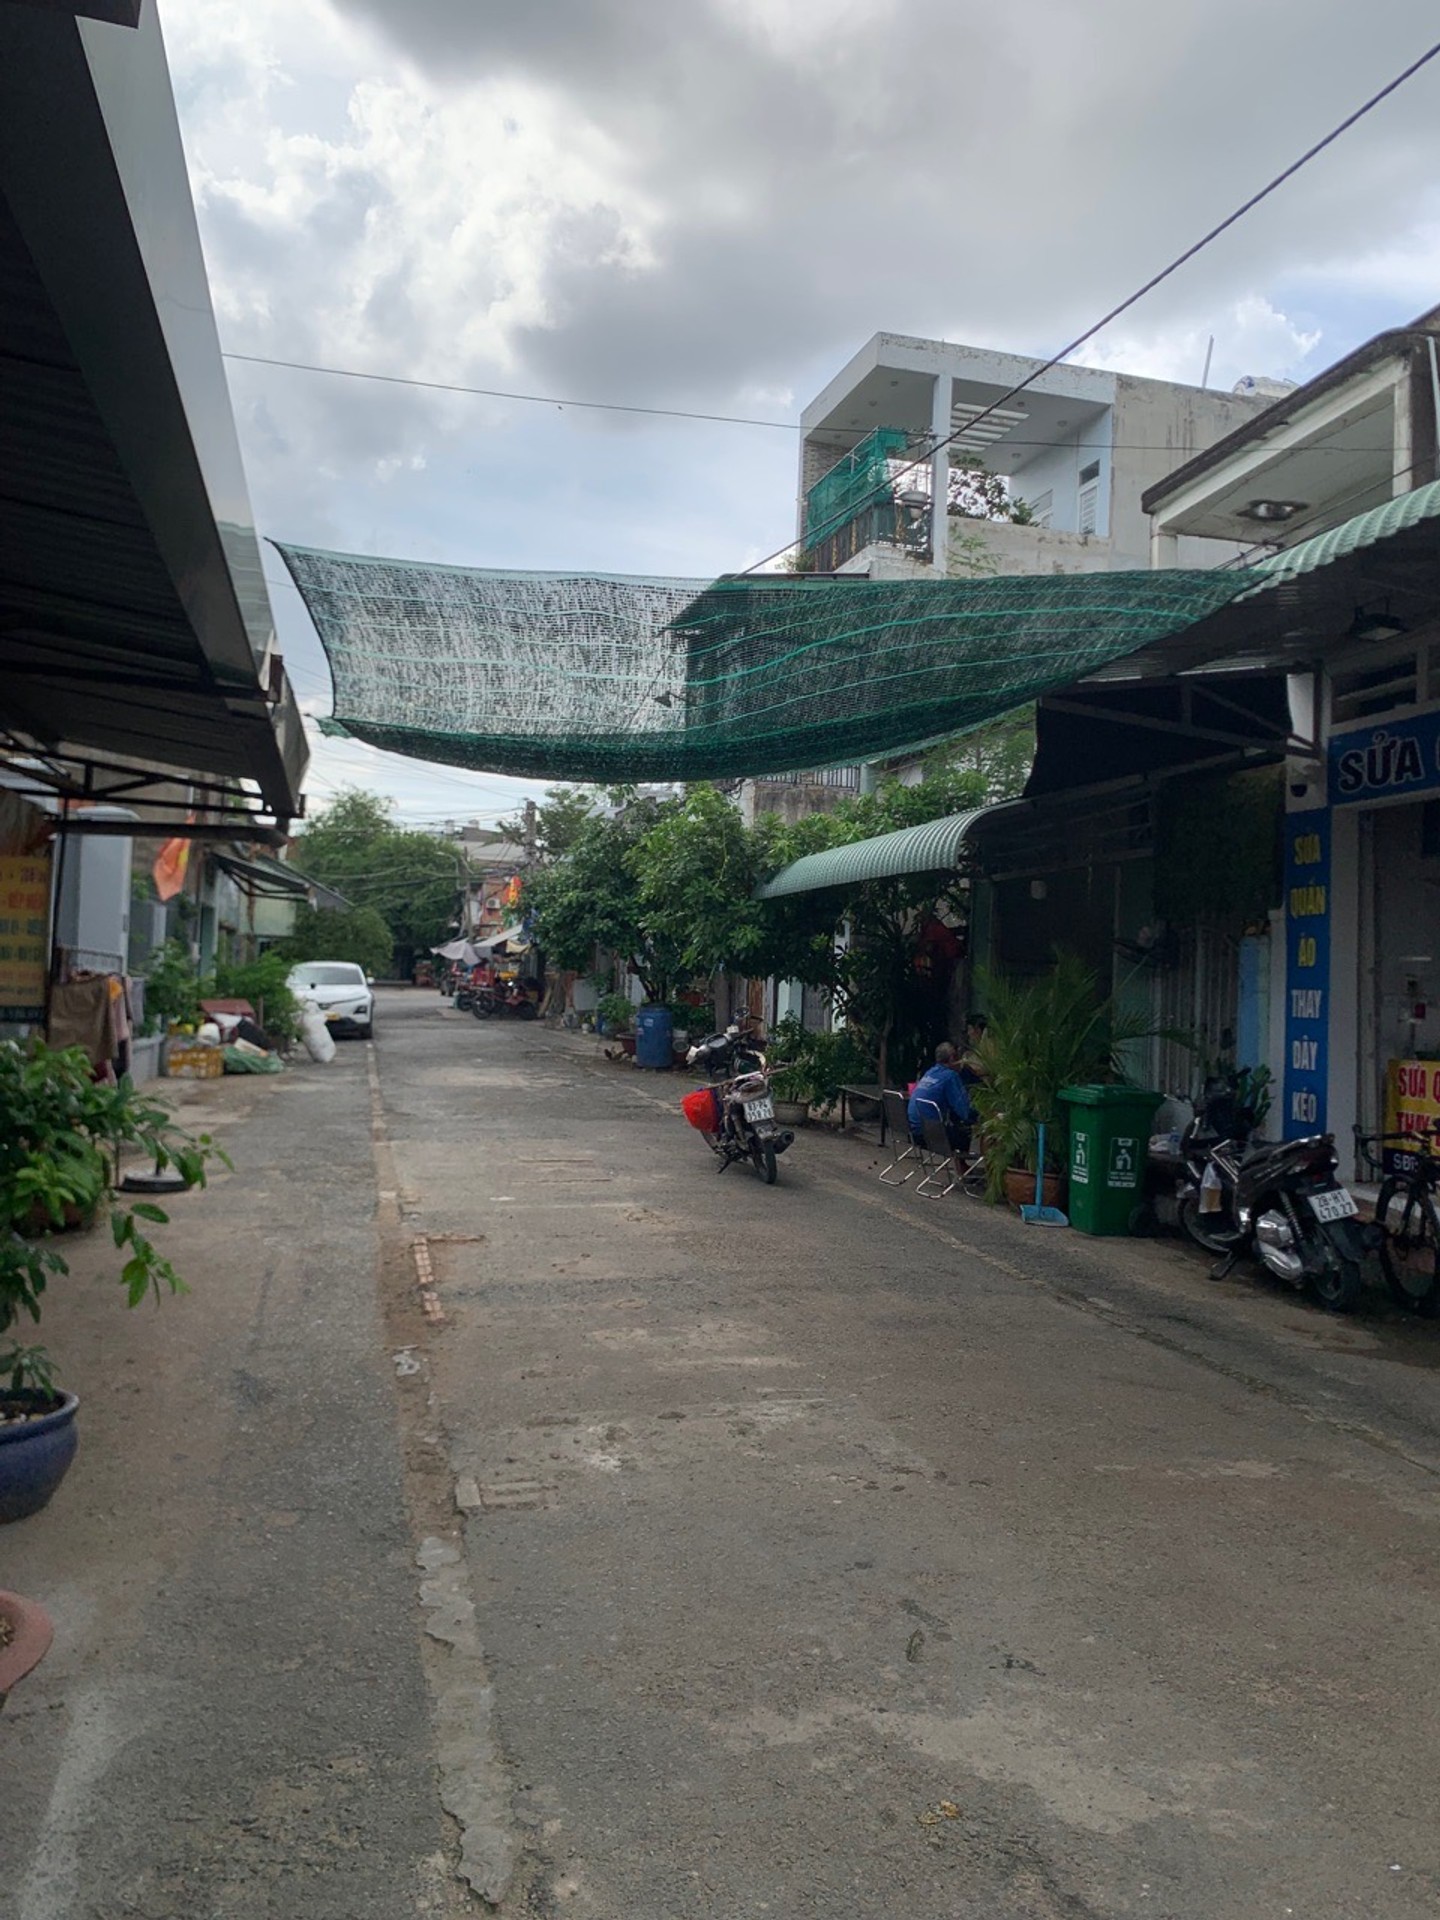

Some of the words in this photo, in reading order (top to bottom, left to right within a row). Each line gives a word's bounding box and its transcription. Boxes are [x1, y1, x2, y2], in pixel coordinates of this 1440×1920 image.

[1338, 730, 1425, 793] SỬA
[1298, 932, 1317, 967] ÁO
[1291, 988, 1322, 1019] THAY
[1292, 1034, 1319, 1071] DÂY
[1291, 1087, 1317, 1124] KÉO
